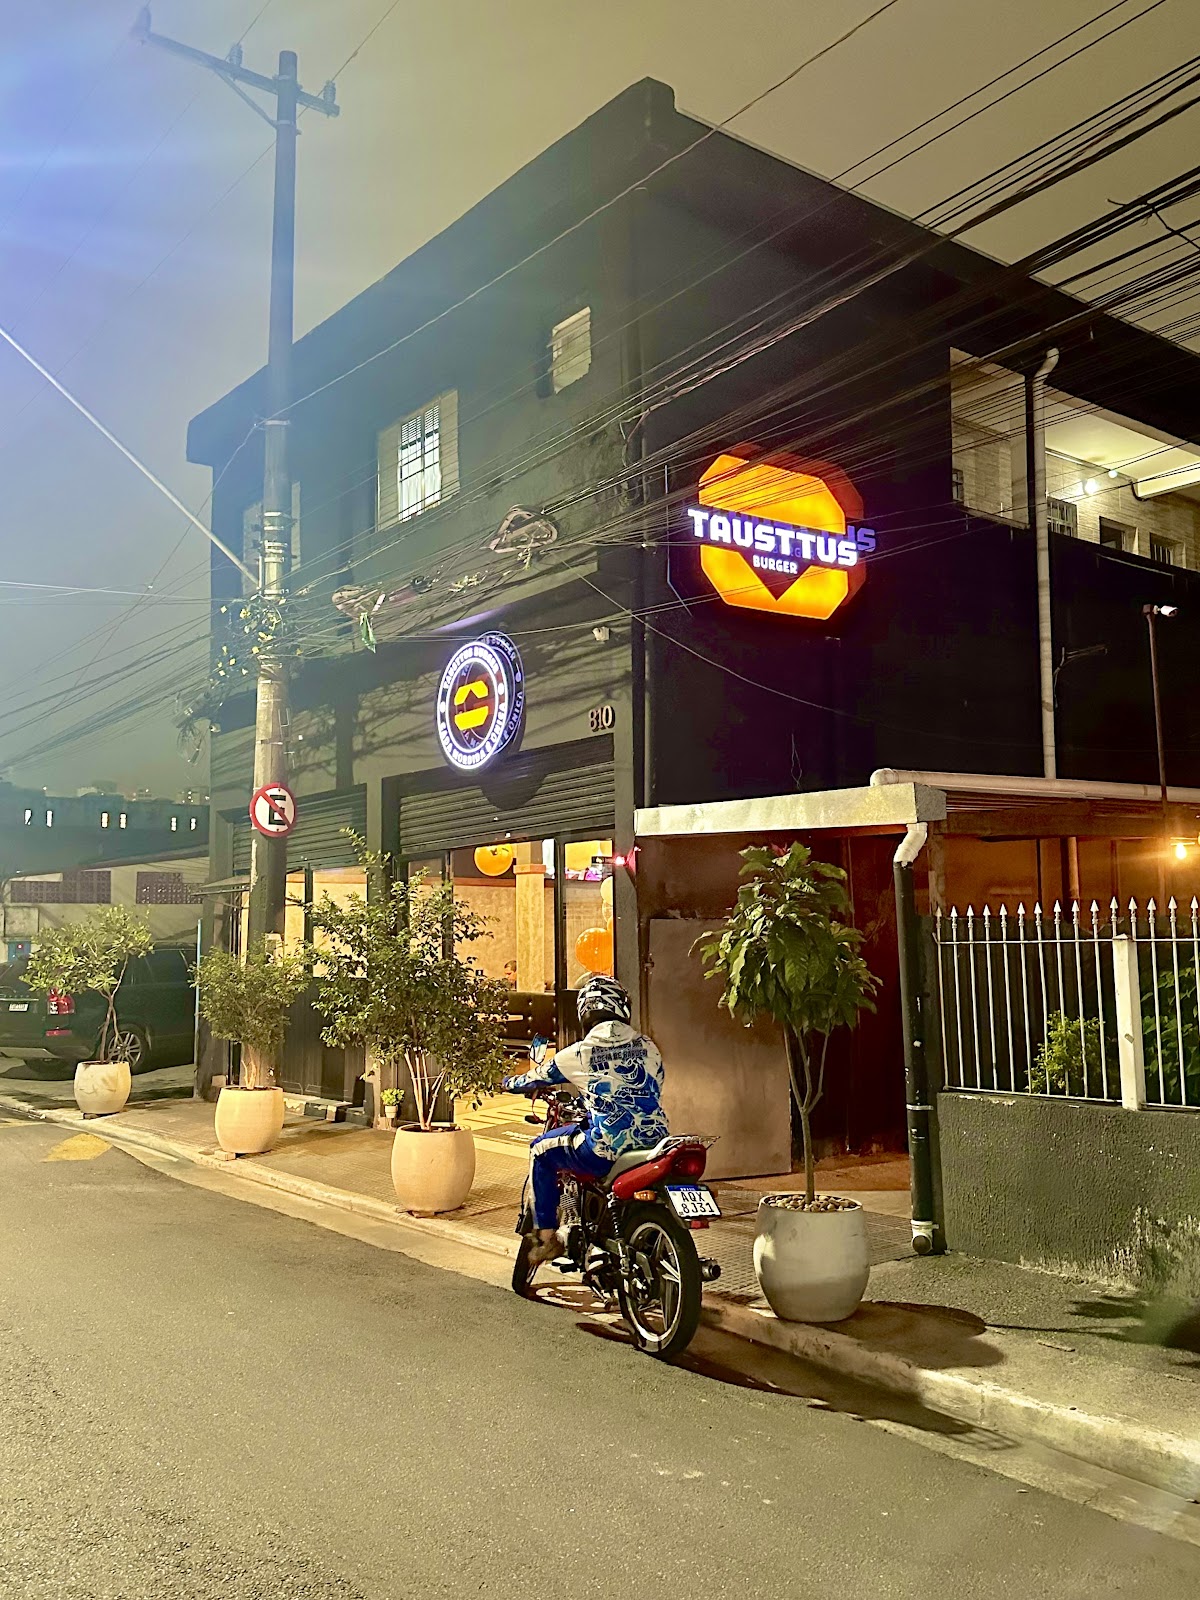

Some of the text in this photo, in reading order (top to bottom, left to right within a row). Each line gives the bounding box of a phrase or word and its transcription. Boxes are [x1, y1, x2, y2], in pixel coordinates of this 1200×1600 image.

[688, 509, 857, 566] TAUSTTUS
[753, 554, 797, 574] BURGER
[589, 705, 613, 731] 810
[681, 1202, 715, 1214] 8J31
